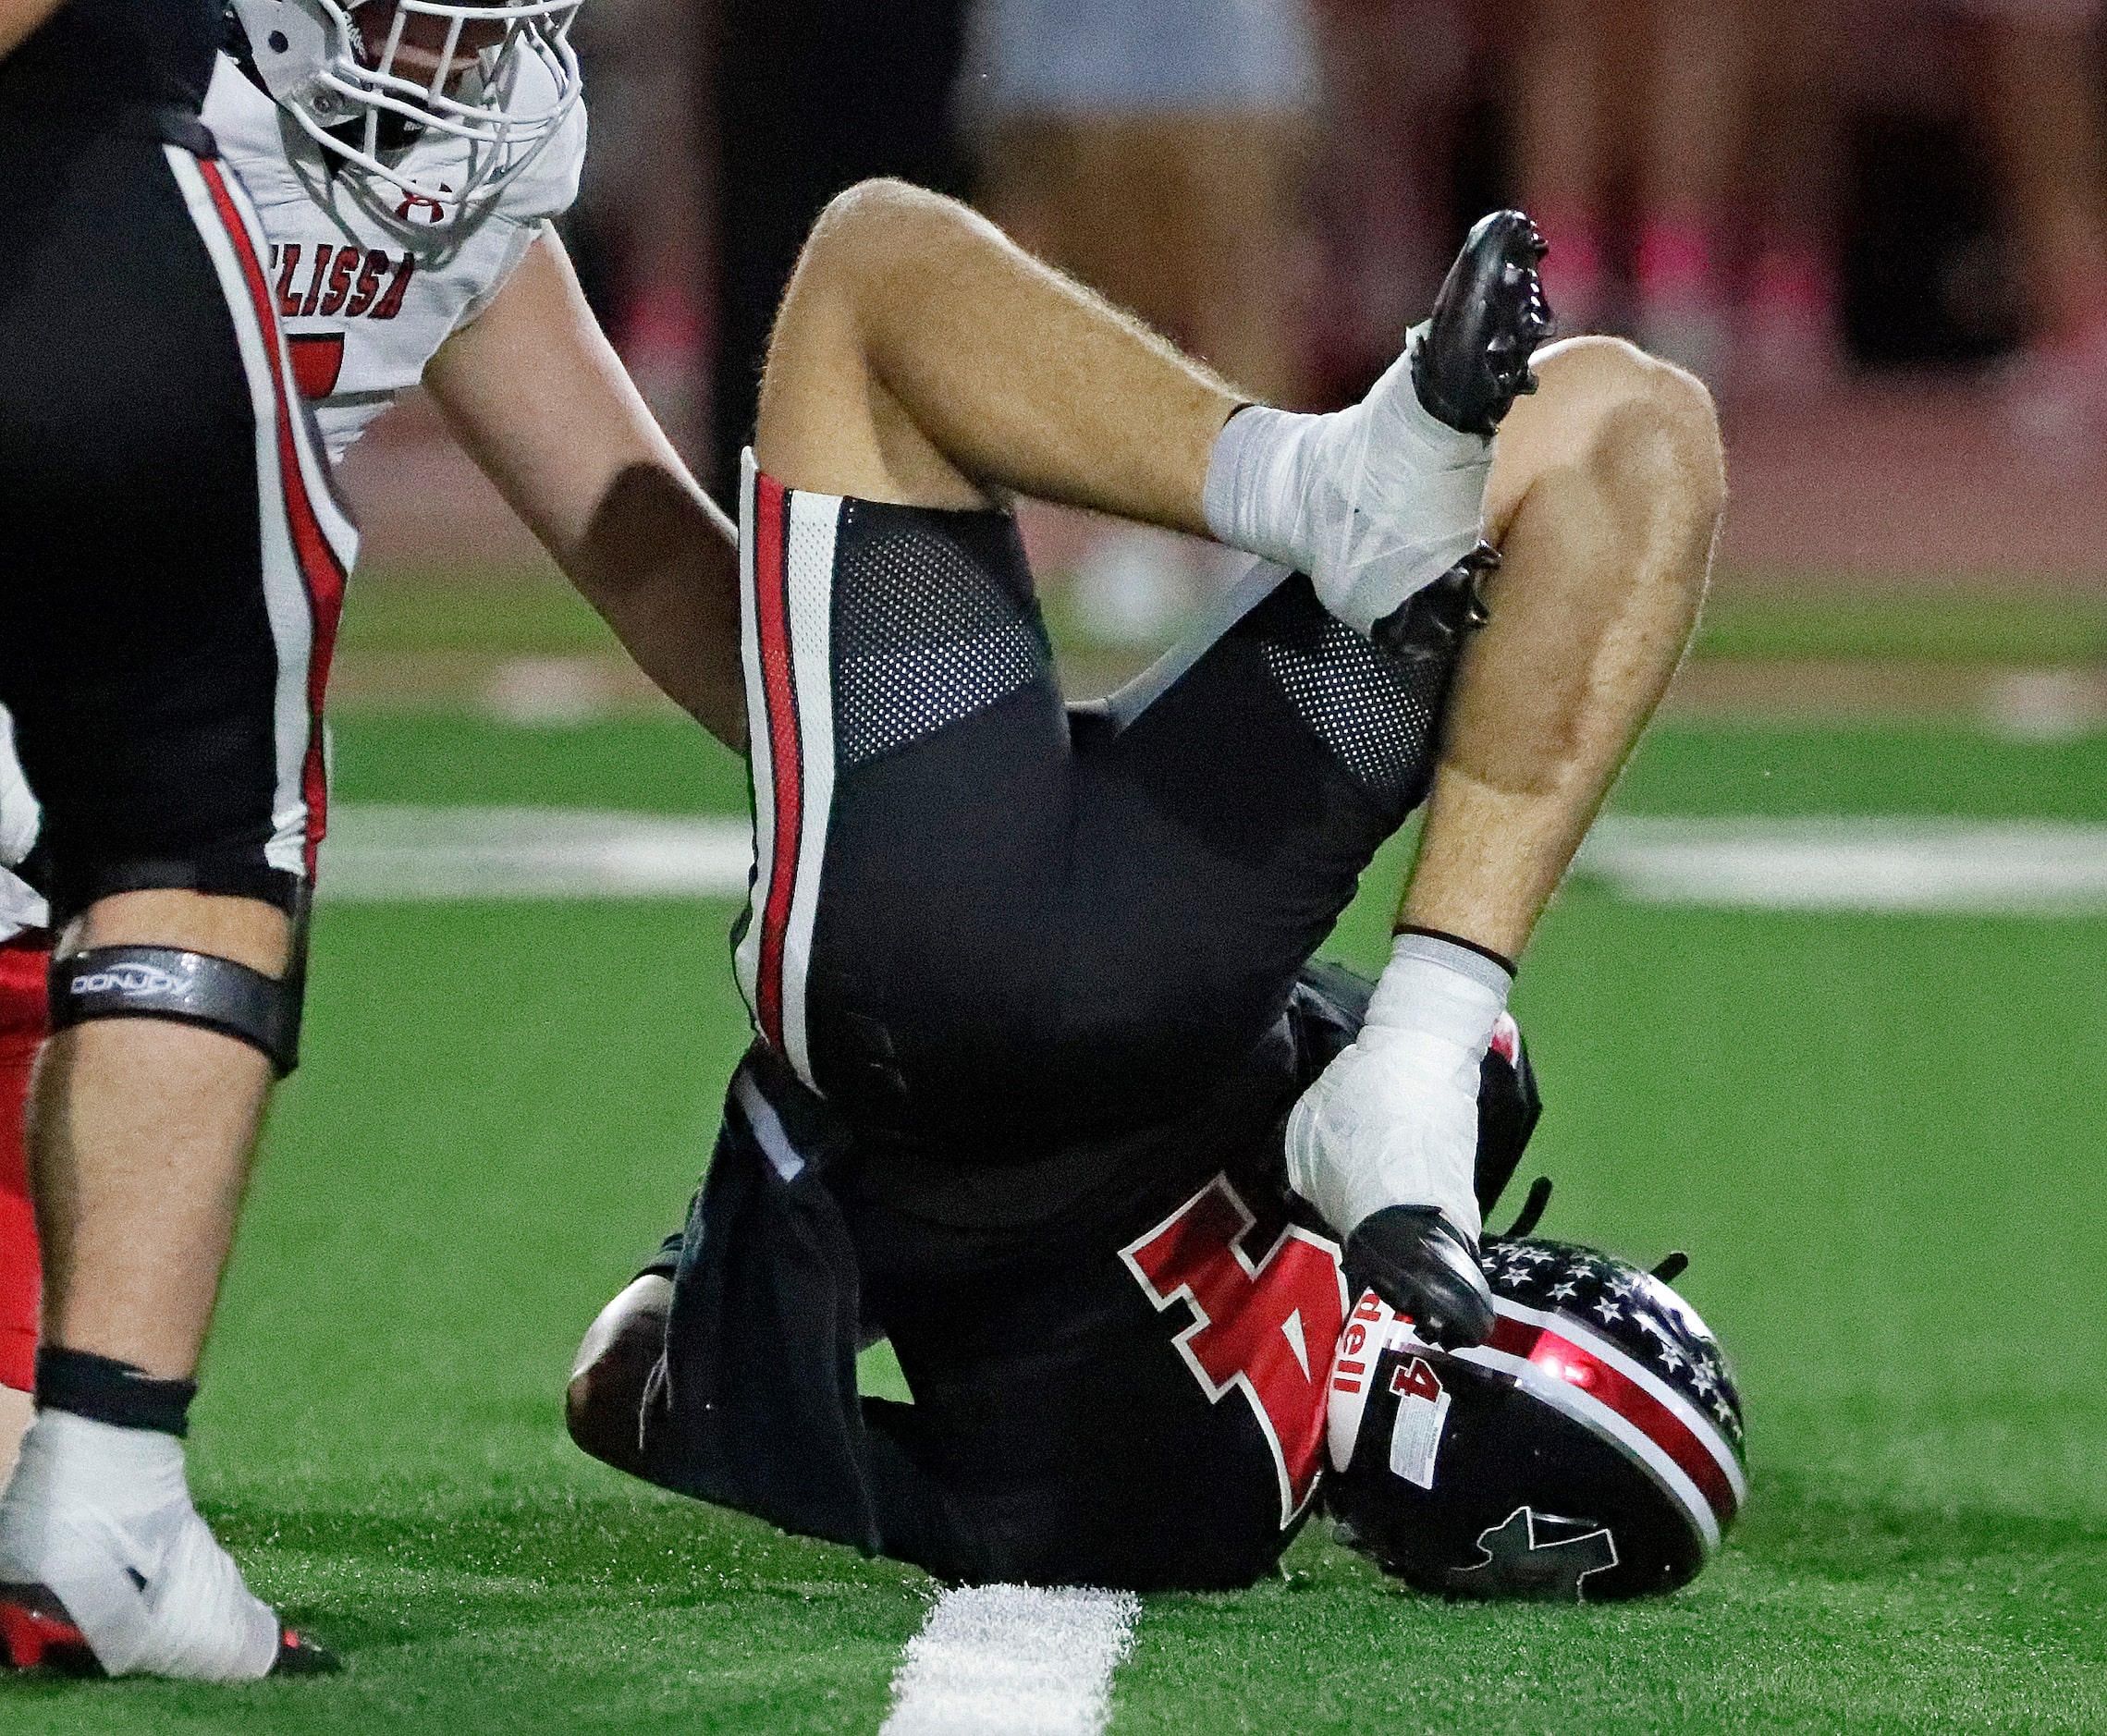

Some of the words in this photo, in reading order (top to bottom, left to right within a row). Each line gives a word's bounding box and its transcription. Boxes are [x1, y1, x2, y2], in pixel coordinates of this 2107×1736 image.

[268, 243, 416, 319] LISSA
[1118, 1170, 1349, 1531] 4
[1389, 1356, 1442, 1402] 4
